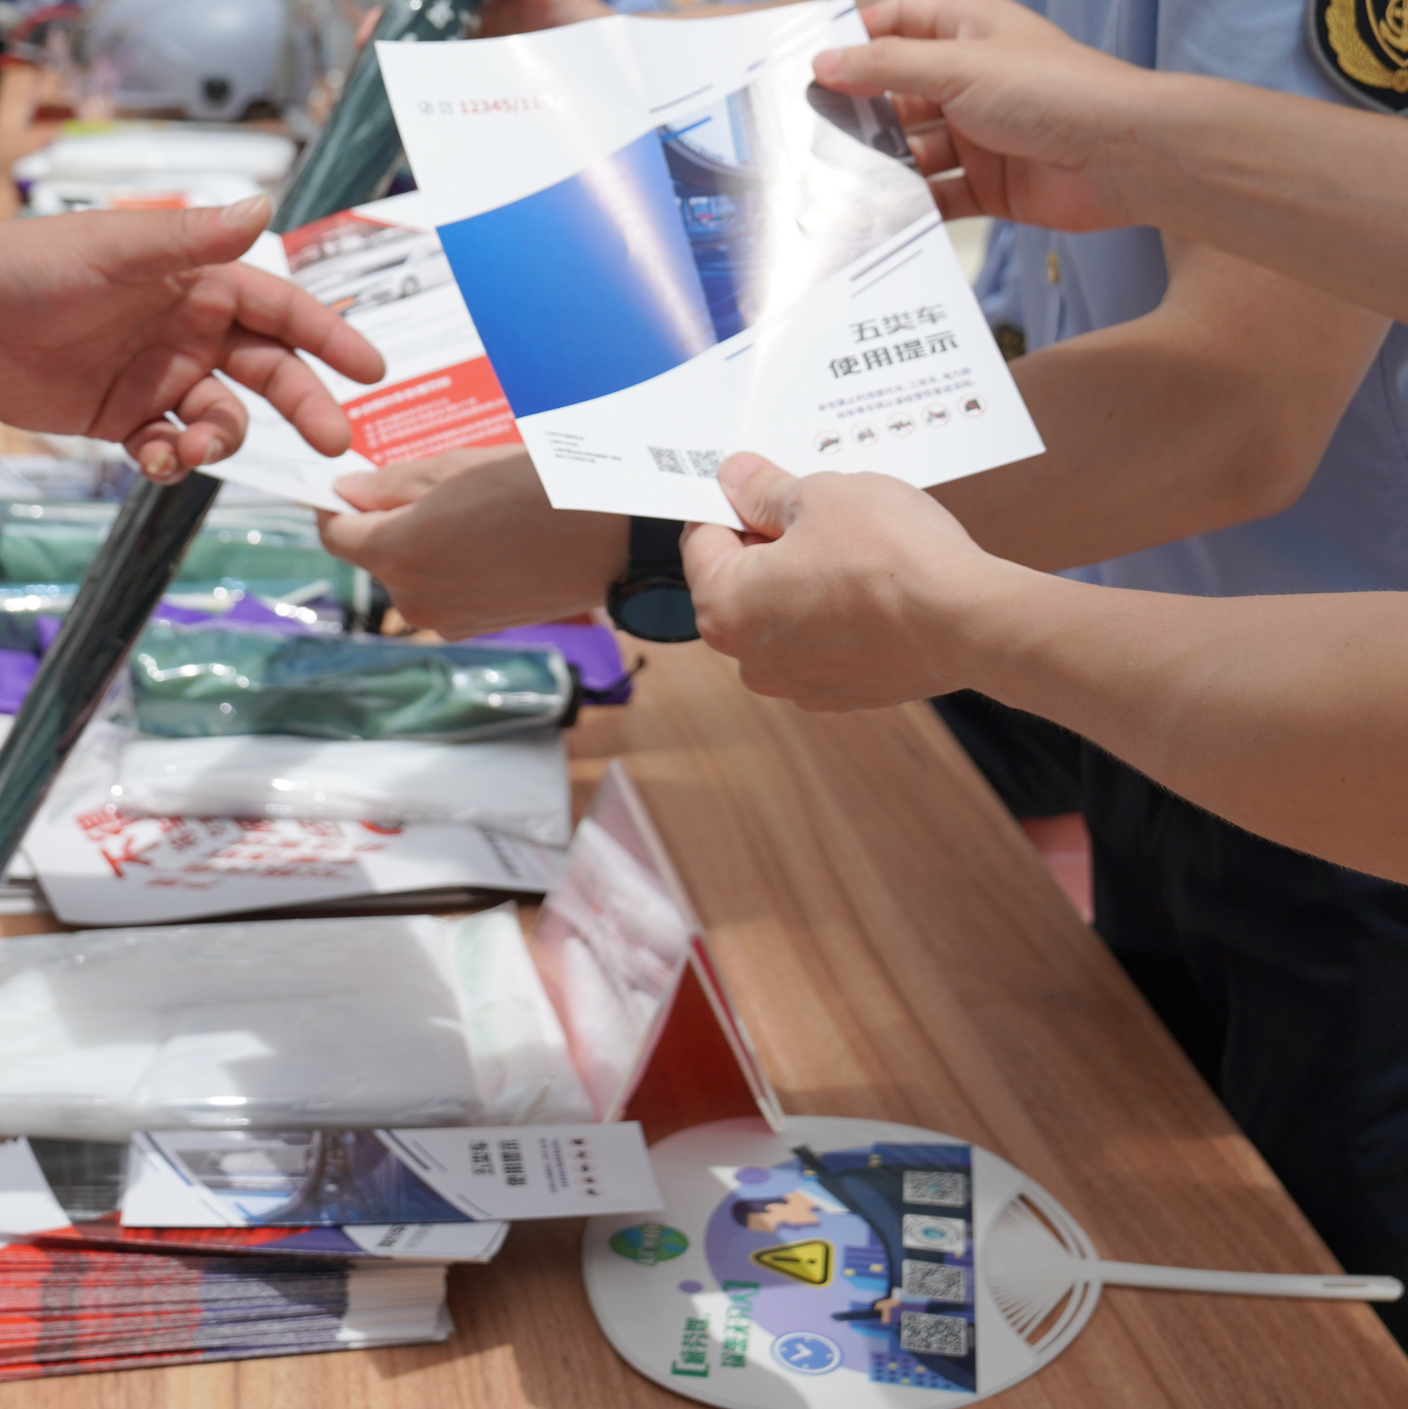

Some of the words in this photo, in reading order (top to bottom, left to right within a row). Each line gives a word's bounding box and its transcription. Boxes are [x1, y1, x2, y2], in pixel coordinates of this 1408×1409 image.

[850, 303, 948, 343] 五类车
[828, 330, 960, 379] 使用提示
